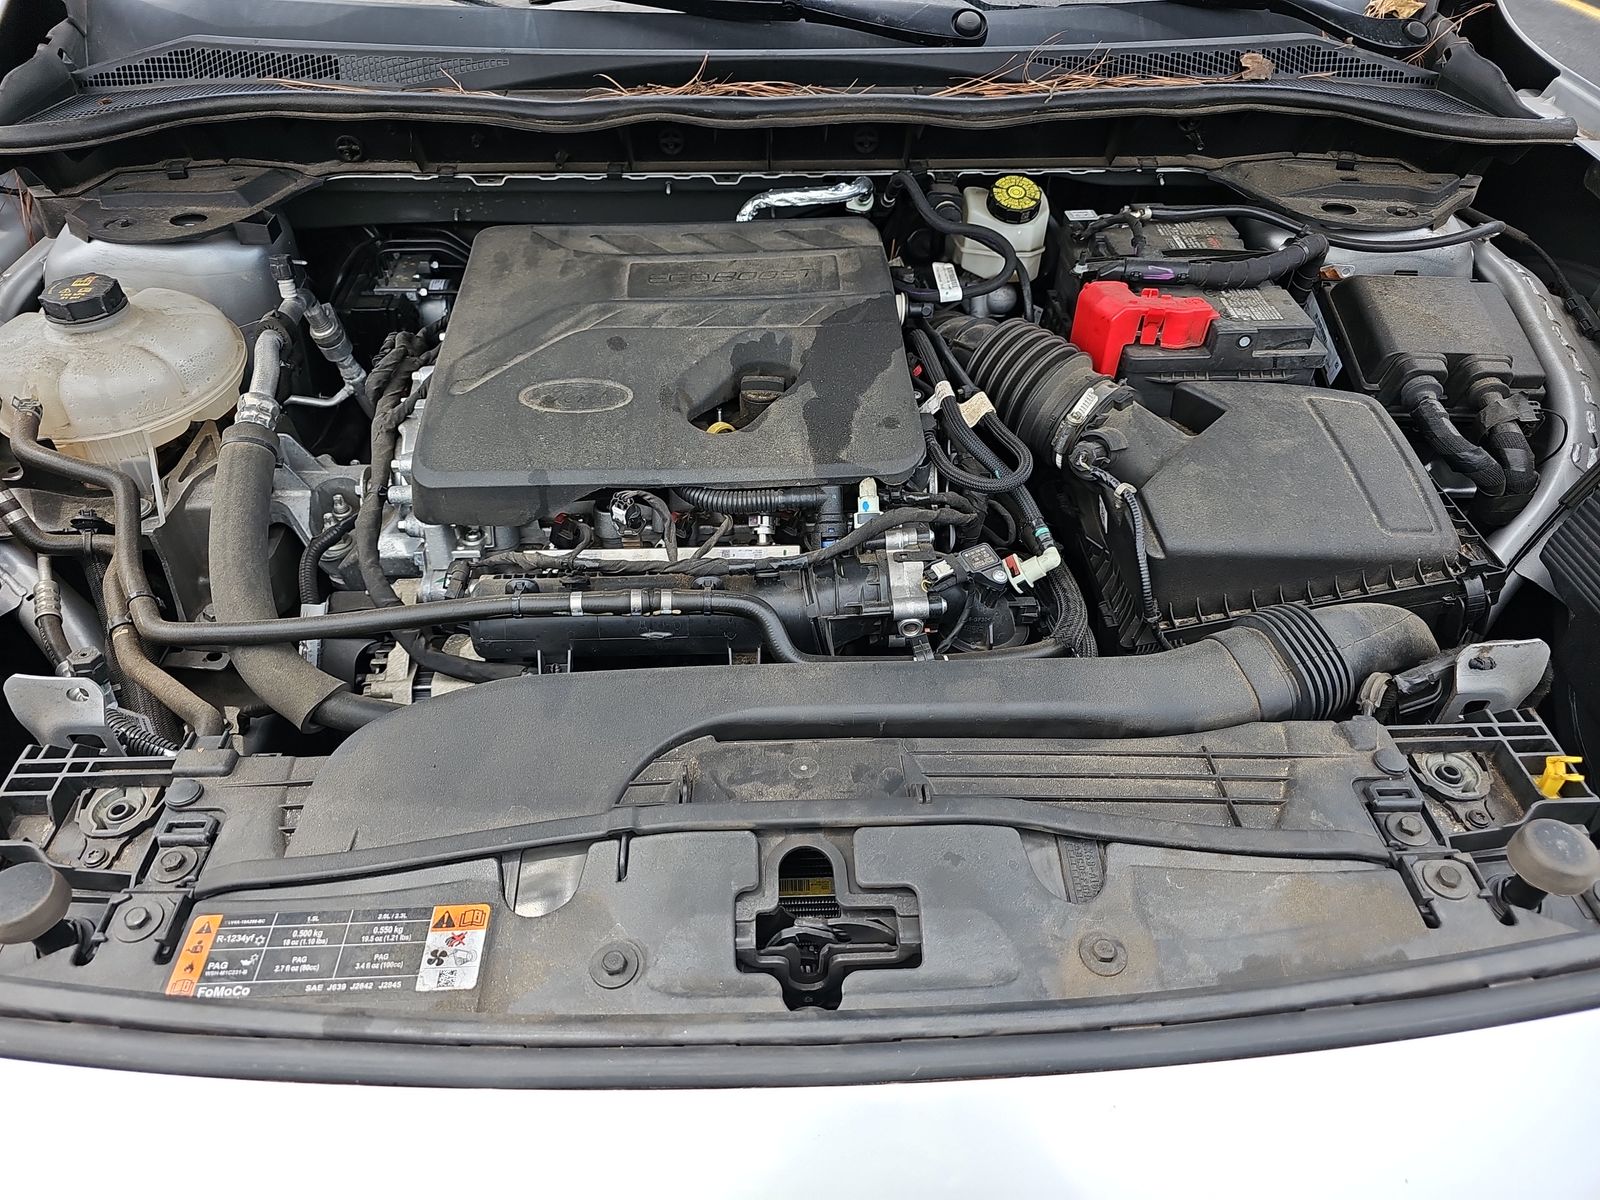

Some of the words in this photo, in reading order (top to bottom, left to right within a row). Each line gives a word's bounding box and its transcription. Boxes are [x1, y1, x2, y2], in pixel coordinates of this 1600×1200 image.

[648, 268, 814, 284] ECOBOOST
[292, 929, 313, 938] 0.500
[313, 929, 324, 938] kg
[373, 925, 393, 935] 0.550
[394, 925, 404, 935] kg
[216, 933, 256, 944] R-1234yf
[361, 935, 374, 943] 19.5
[291, 955, 308, 964] PAG
[373, 953, 389, 961] PAG
[207, 961, 229, 970] PAG
[196, 985, 251, 998] FoMoCo
[305, 983, 324, 992] SAE
[326, 983, 347, 991] J639
